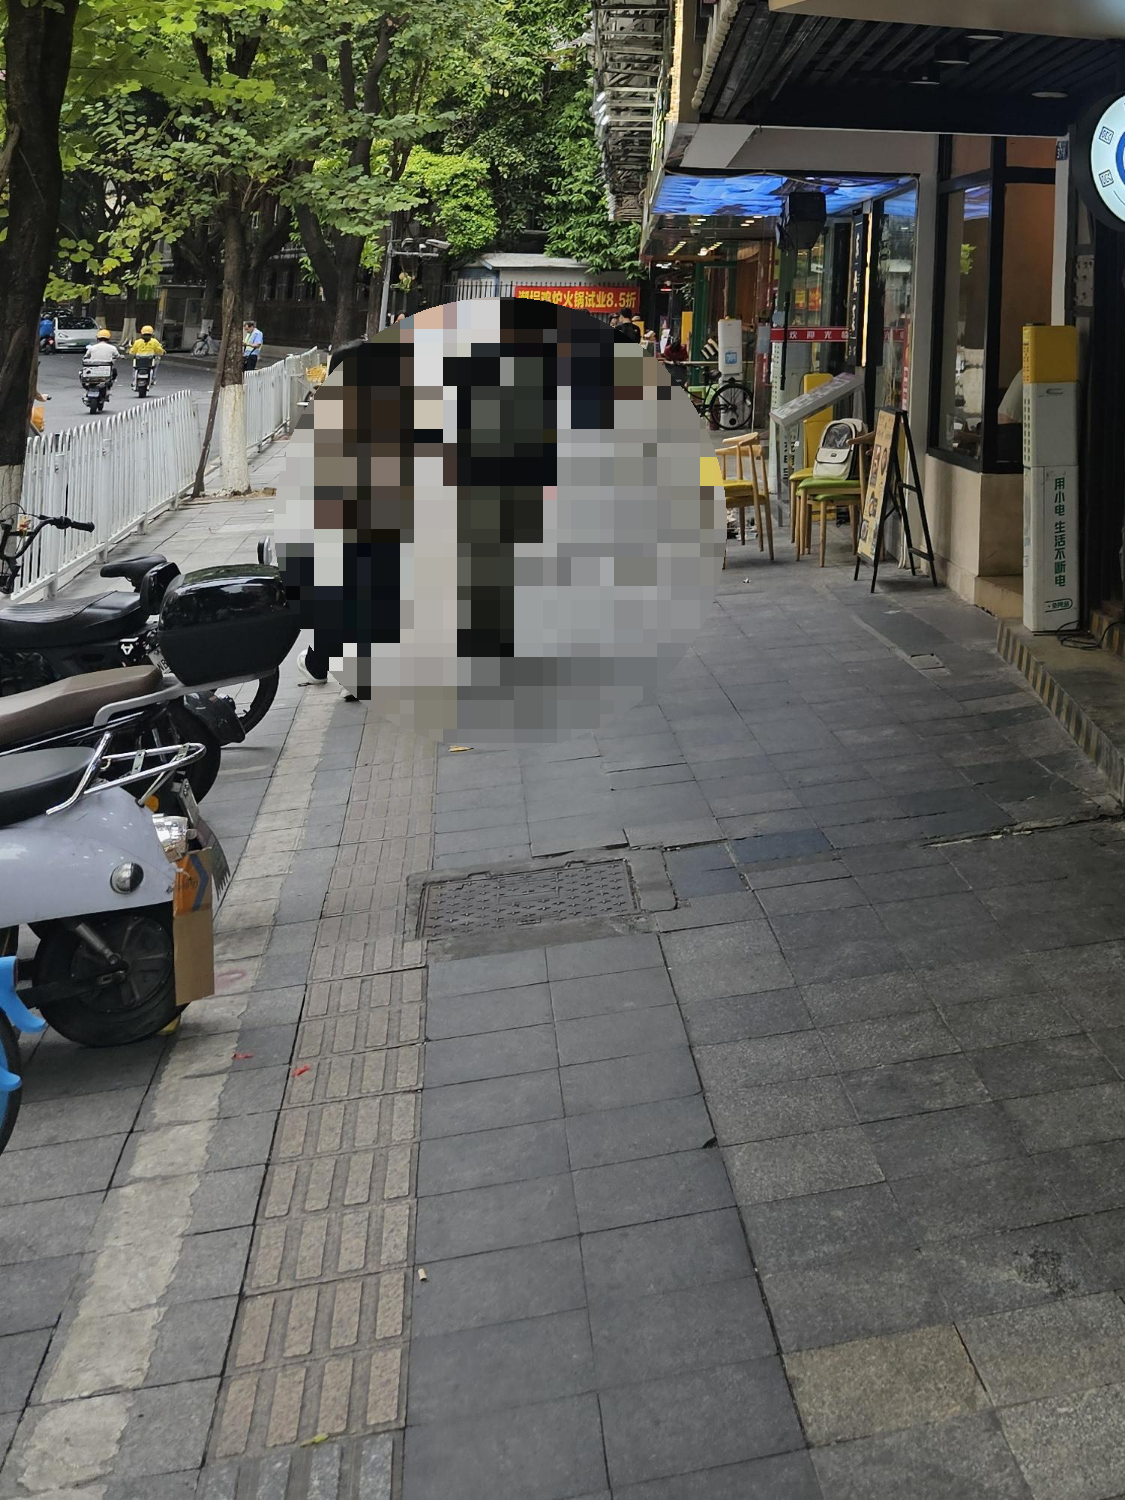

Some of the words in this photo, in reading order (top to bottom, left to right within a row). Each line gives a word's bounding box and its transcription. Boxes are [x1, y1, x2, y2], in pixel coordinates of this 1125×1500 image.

[1054, 477, 1066, 516] 用小电
[1054, 520, 1066, 587] 生活不断电
